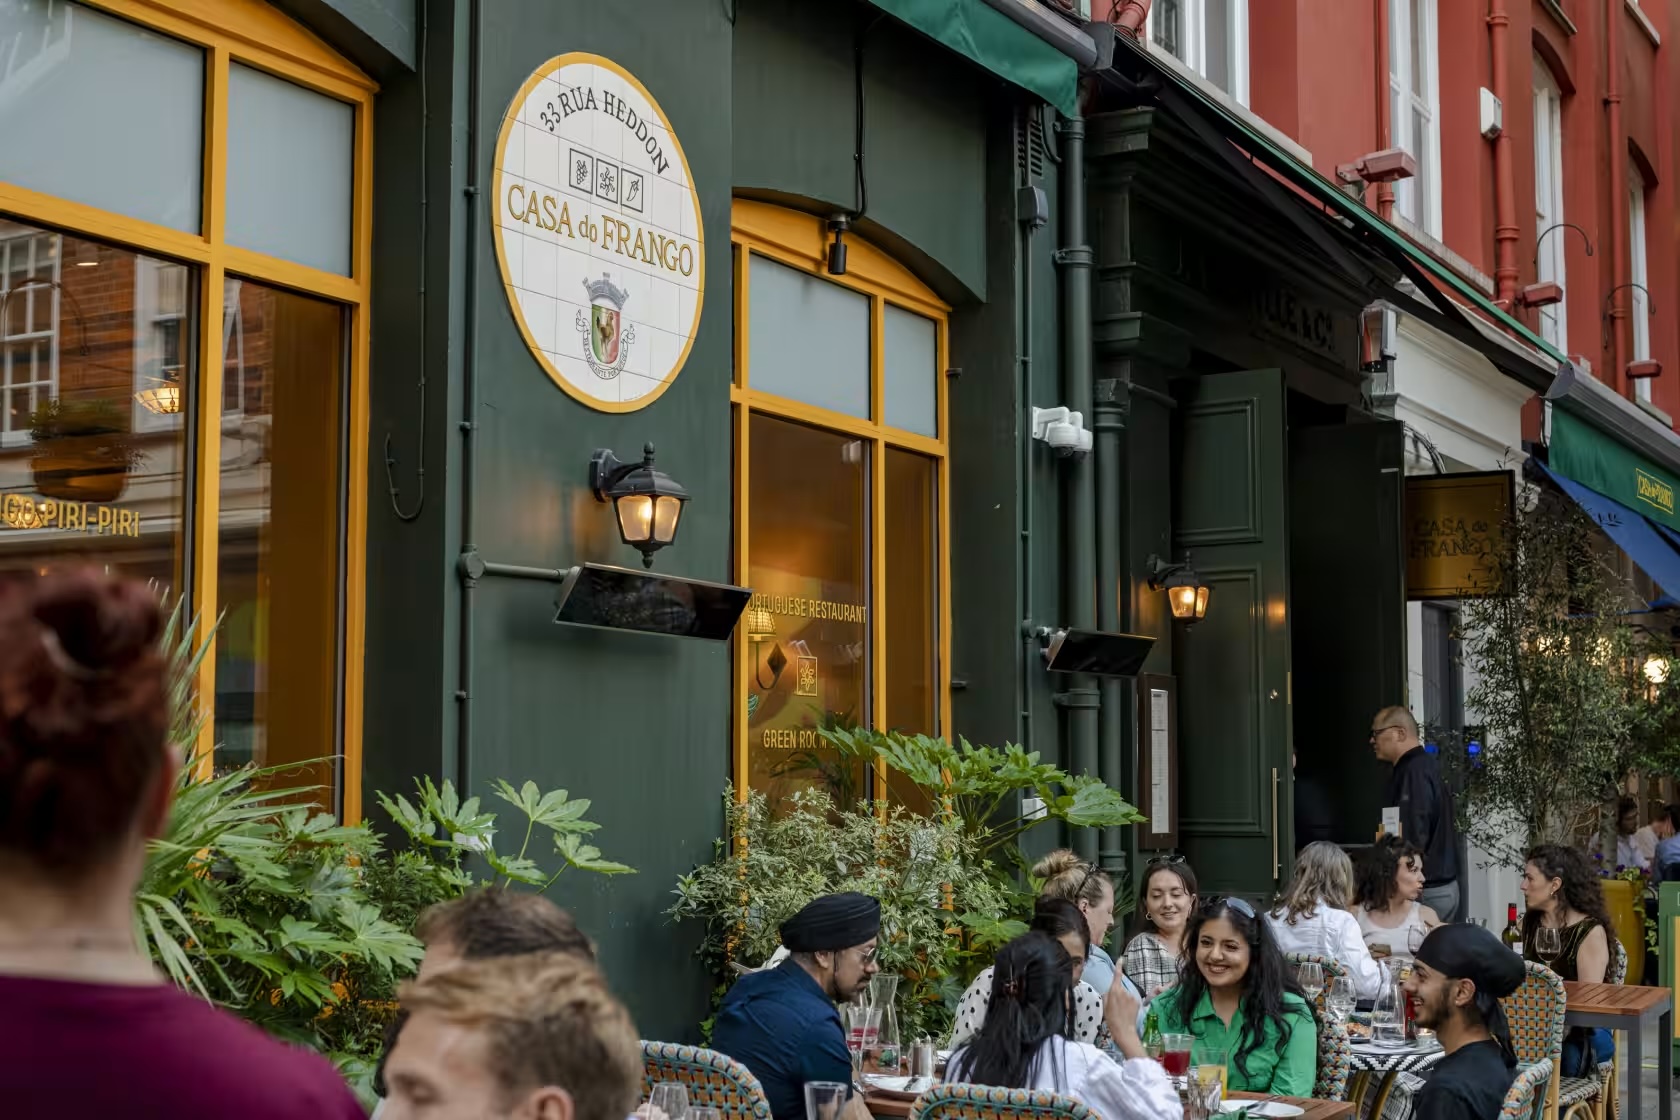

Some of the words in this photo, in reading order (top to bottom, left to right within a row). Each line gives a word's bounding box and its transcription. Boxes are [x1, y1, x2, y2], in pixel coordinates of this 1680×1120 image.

[540, 101, 561, 132] 33
[558, 86, 599, 118] RUA
[603, 90, 670, 175] HEDDON
[507, 184, 575, 238] CASA
[578, 214, 598, 243] do
[601, 214, 694, 277] FRANGO
[0, 492, 36, 526] GO
[43, 499, 140, 538] PIRI-PIRI
[748, 592, 806, 618] ORTUGUESE
[809, 599, 867, 624] RESTAURANT
[763, 728, 797, 750] GREEN
